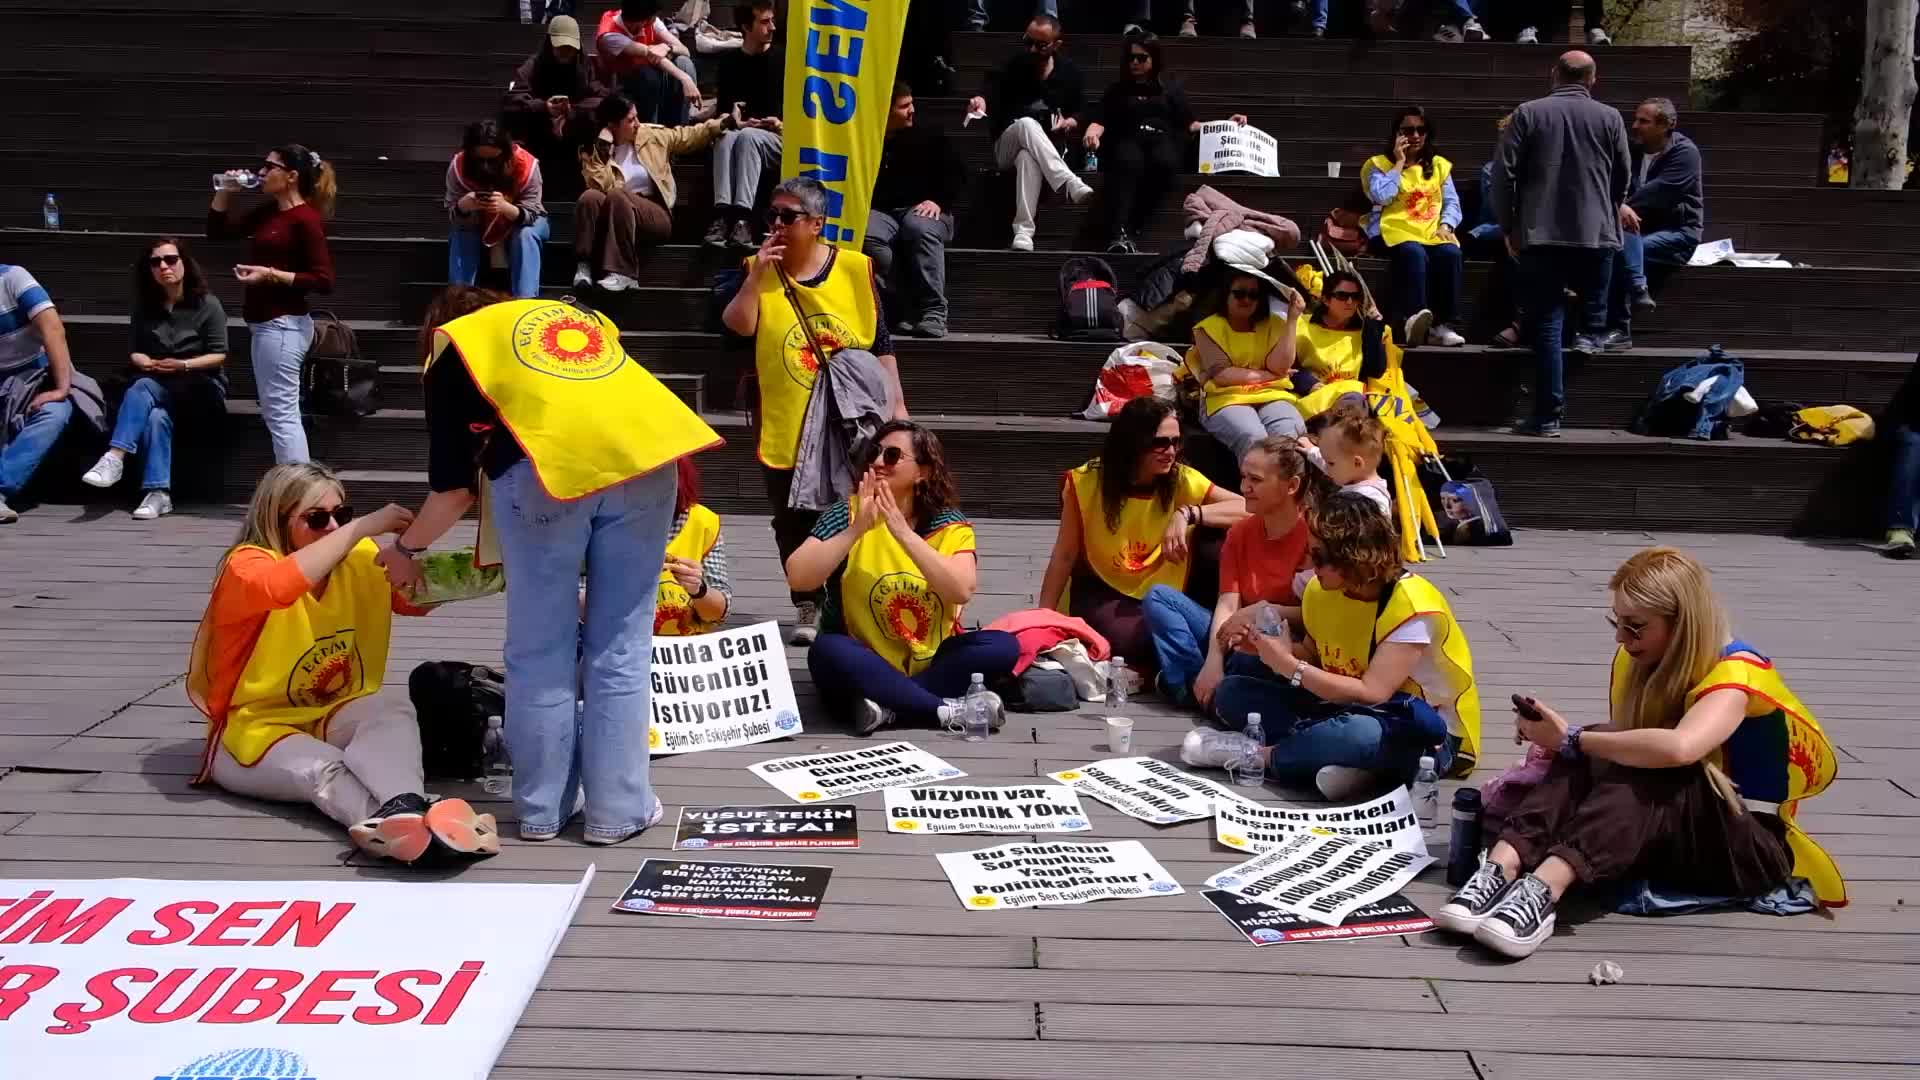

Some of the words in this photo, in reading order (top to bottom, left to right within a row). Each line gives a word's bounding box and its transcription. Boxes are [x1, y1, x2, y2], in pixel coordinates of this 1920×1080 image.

[718, 633, 768, 660] Can
[650, 660, 768, 694] Güvenliği
[652, 688, 772, 724] İstiyoruz!
[664, 731, 689, 750] Eğitim
[689, 730, 705, 746] Sen
[743, 720, 771, 741] Şubesi
[763, 754, 856, 772] Güvenli
[809, 757, 902, 776] Güvenli
[816, 764, 926, 787] Gelecek!
[911, 788, 998, 802] Vizyon
[1137, 778, 1190, 800] Bakan
[686, 811, 768, 820] YUSUF
[776, 808, 852, 819] TEKİN
[891, 804, 1014, 820] Güvenlik
[1016, 804, 1081, 818] YOK!
[1315, 800, 1396, 822] varken
[702, 820, 834, 834] İSTİFA!
[1301, 813, 1416, 836] asalları
[972, 850, 1005, 861] Bu
[981, 854, 1116, 872] Sorumlusu
[662, 868, 689, 877] BİR
[739, 874, 806, 882] YARATAN
[680, 864, 705, 872] BİR
[709, 866, 792, 876] ÇOCUKTAN
[1017, 864, 1094, 878] Yanlış
[662, 884, 790, 894] SORGULAMADAN
[688, 878, 774, 887] KARANLIĞI
[632, 888, 690, 898] HİÇBİR
[692, 892, 721, 900] ŞEY
[724, 893, 816, 903] YAPILAMAZ!
[1003, 894, 1038, 906] Eğitim
[1040, 892, 1058, 902] Sen
[1060, 888, 1106, 902] Eskişehir
[1108, 886, 1142, 896] Şubesi
[1348, 905, 1415, 917] ILAMAZ!
[126, 899, 357, 948] SEN
[46, 960, 486, 1034] ŞUBESİ
